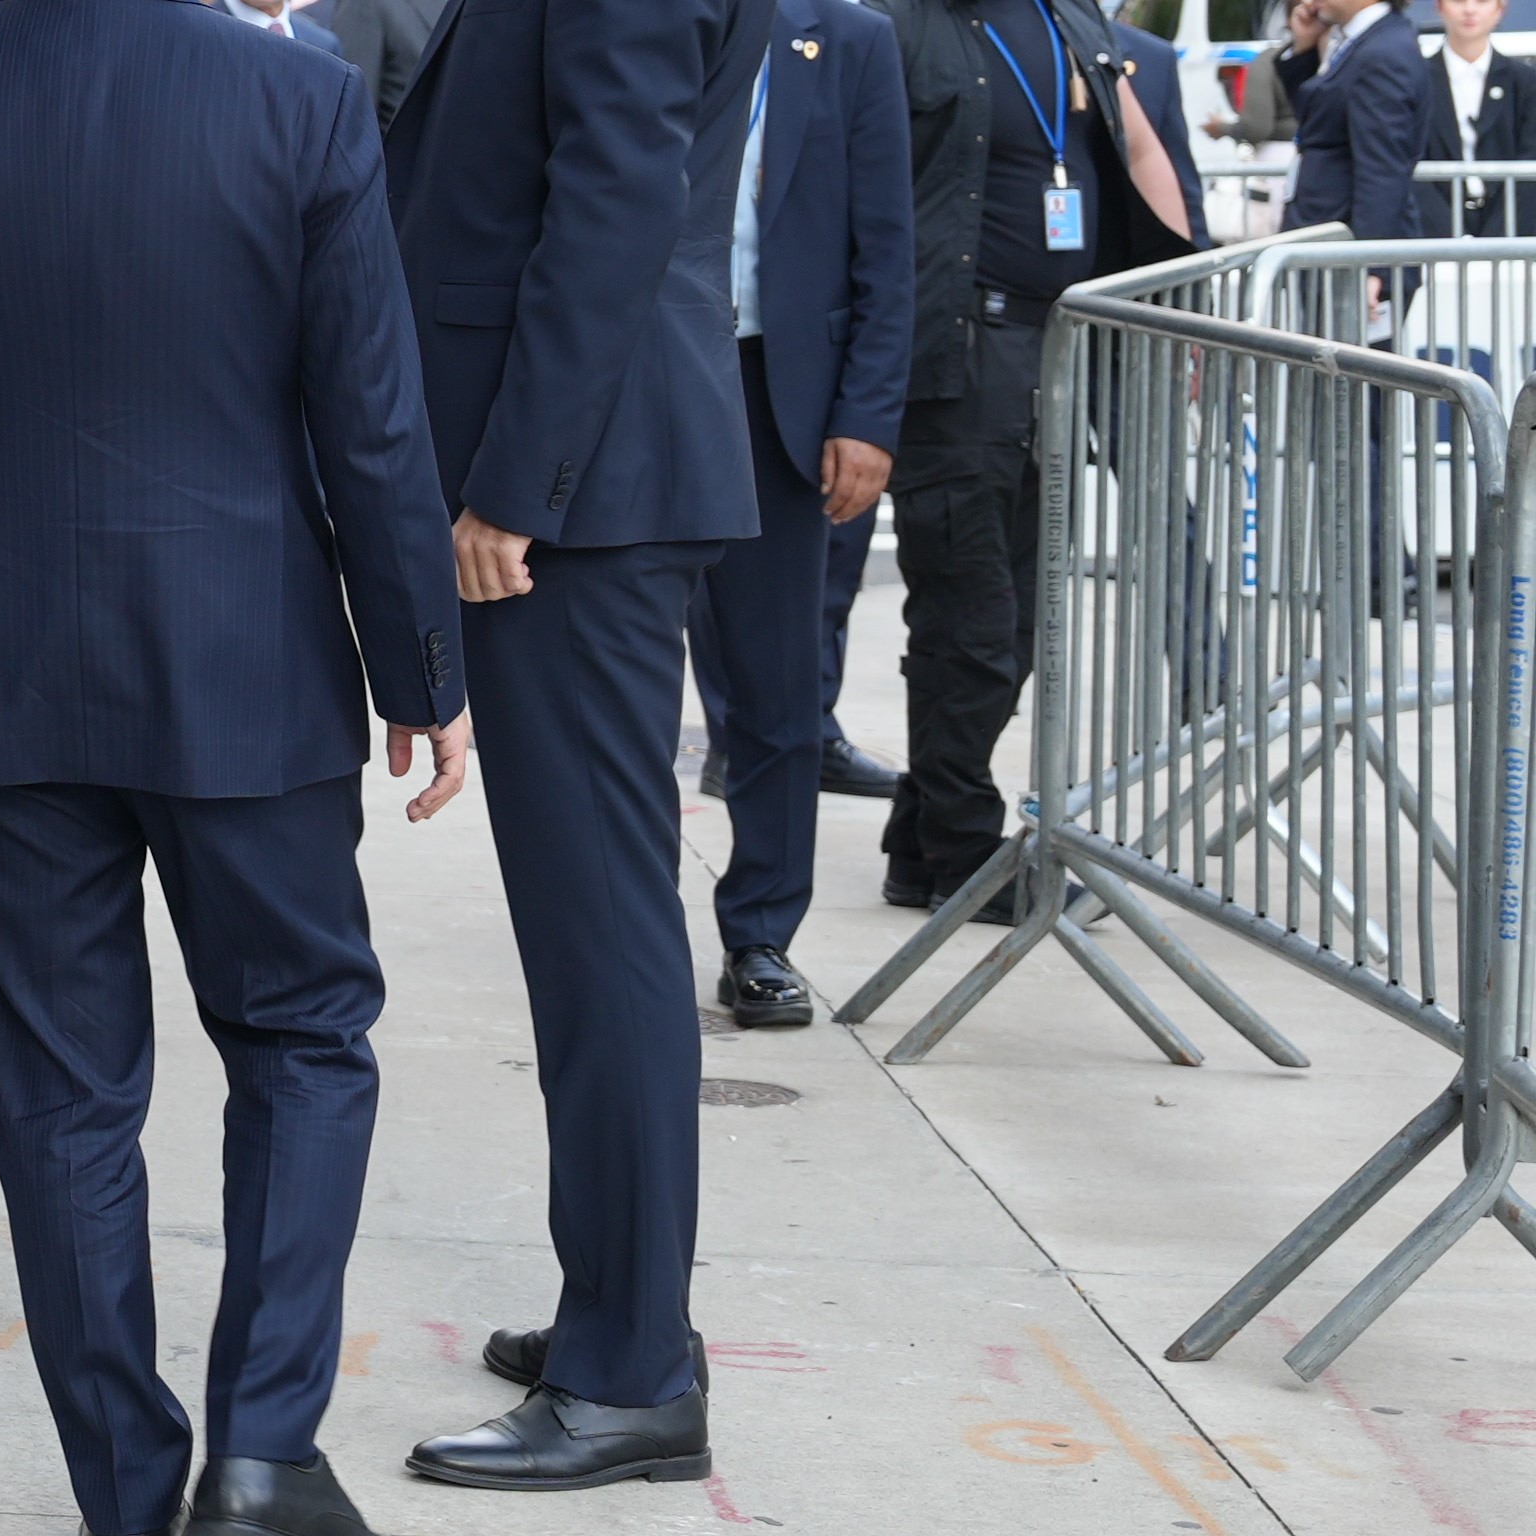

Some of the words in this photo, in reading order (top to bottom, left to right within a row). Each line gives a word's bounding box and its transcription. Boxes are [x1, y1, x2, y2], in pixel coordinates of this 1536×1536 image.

[1506, 575, 1531, 640] Long
[1507, 648, 1529, 728] Fence
[1498, 747, 1526, 942] (800)486-4283
